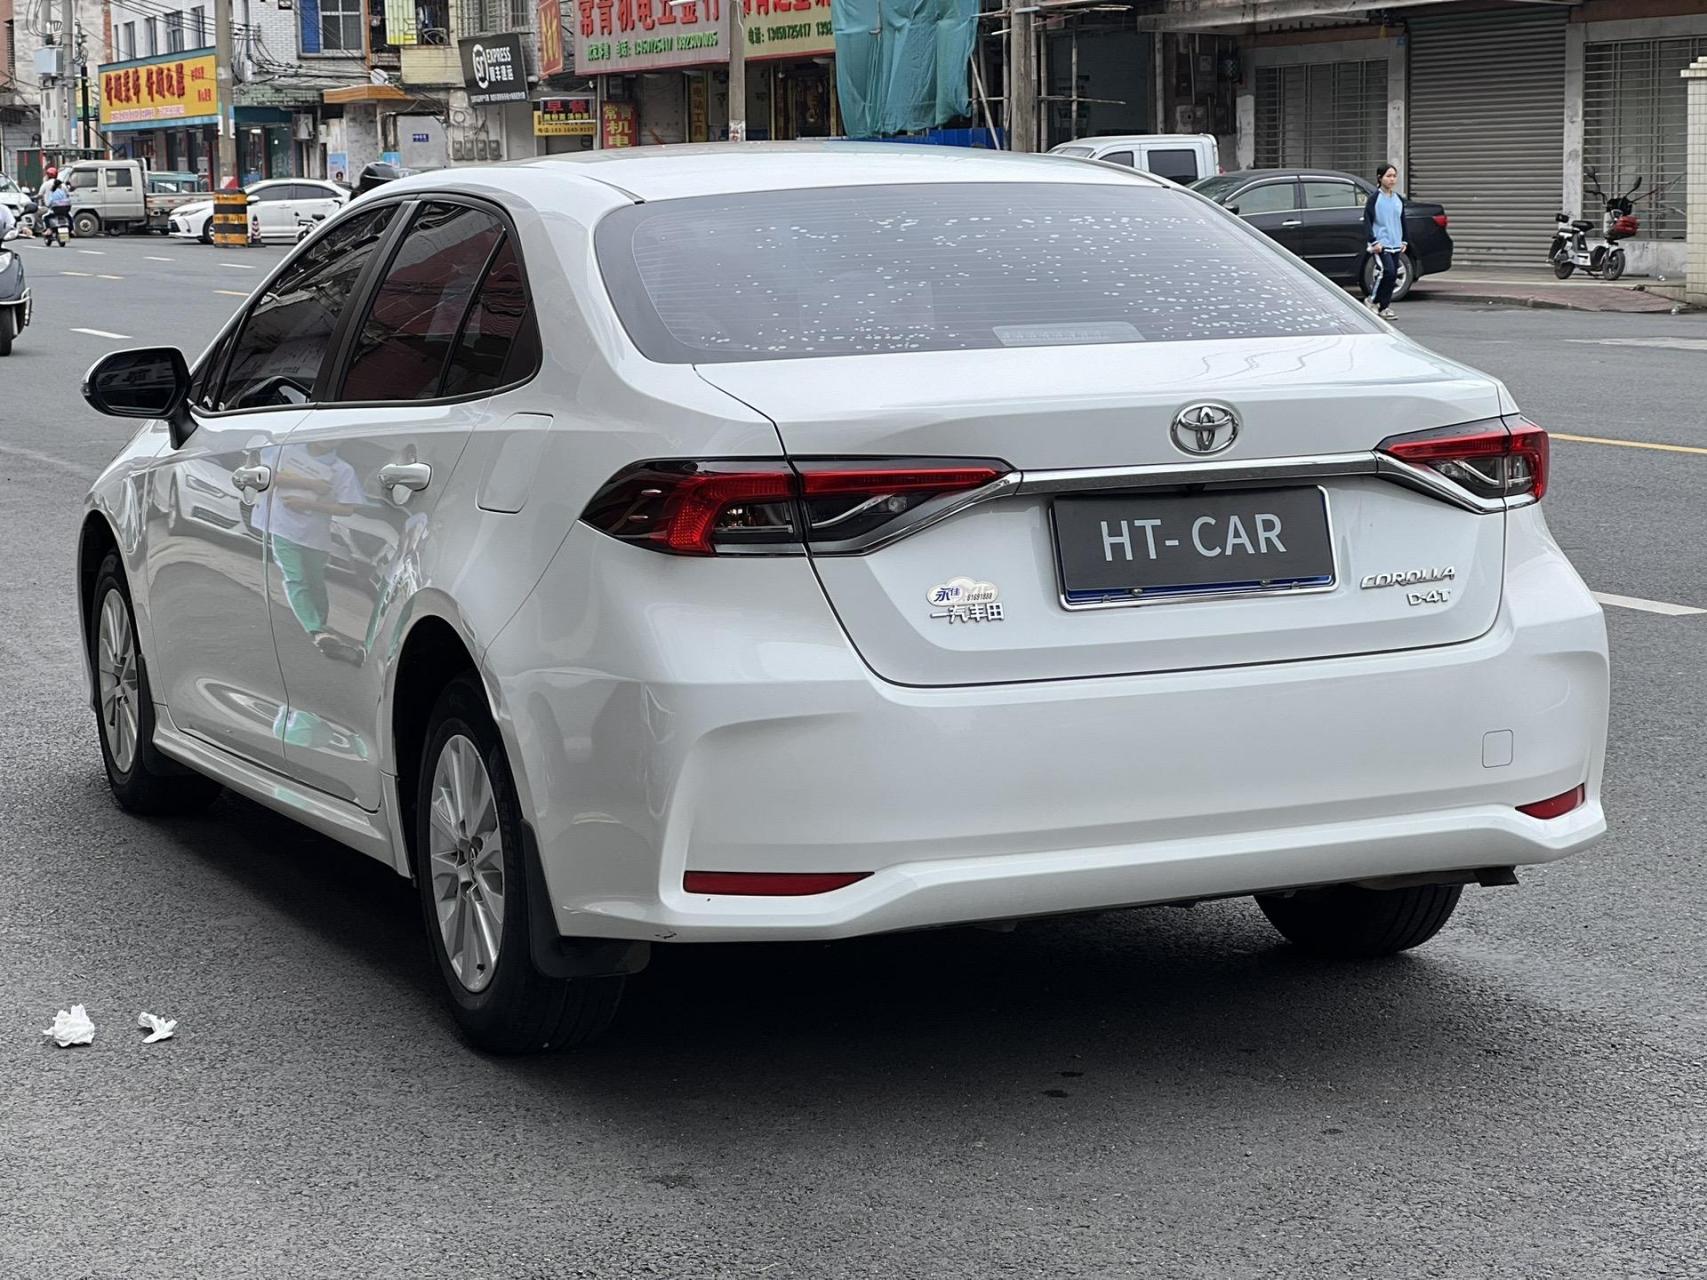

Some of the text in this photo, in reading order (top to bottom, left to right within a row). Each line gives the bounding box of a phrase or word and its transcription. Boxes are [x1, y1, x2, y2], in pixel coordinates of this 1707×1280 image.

[486, 46, 512, 64] EXPRESS
[1100, 513, 1287, 562] HT- CAR
[1361, 566, 1456, 590] COROLLA
[929, 602, 1004, 624] 一汽丰田
